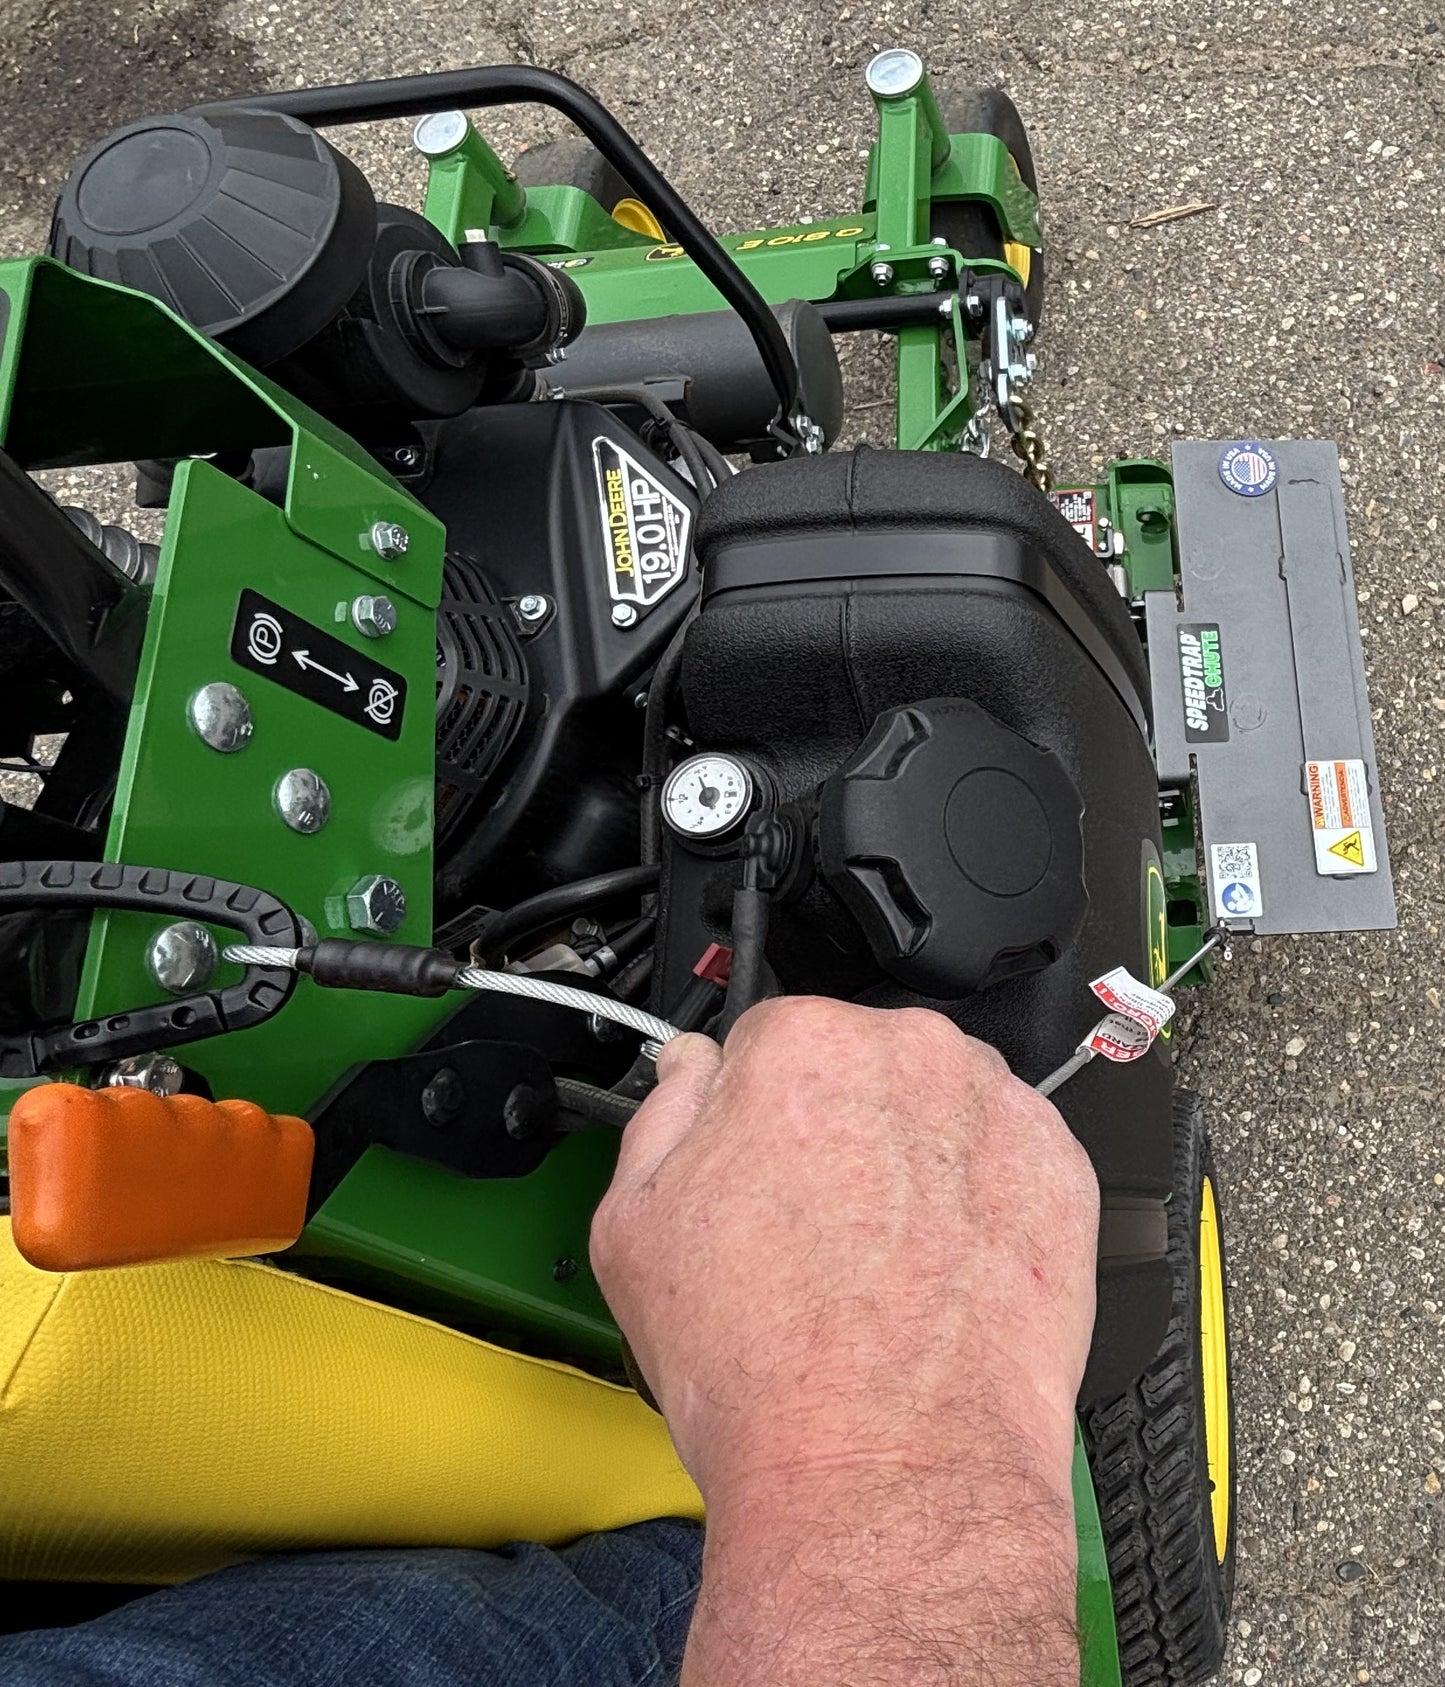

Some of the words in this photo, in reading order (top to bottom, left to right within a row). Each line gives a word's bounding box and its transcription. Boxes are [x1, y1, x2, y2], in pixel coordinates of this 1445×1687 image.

[1222, 460, 1230, 469] IN
[1225, 447, 1241, 461] USA
[1258, 447, 1272, 462] USA
[1223, 470, 1242, 490] MADE
[1259, 471, 1276, 490] MADE
[606, 468, 628, 528] DEERE
[613, 528, 635, 577] JOHN
[1201, 630, 1222, 687] CHUTE
[1180, 633, 1209, 731] SPEEDTRAP
[1308, 765, 1324, 818] WARNING
